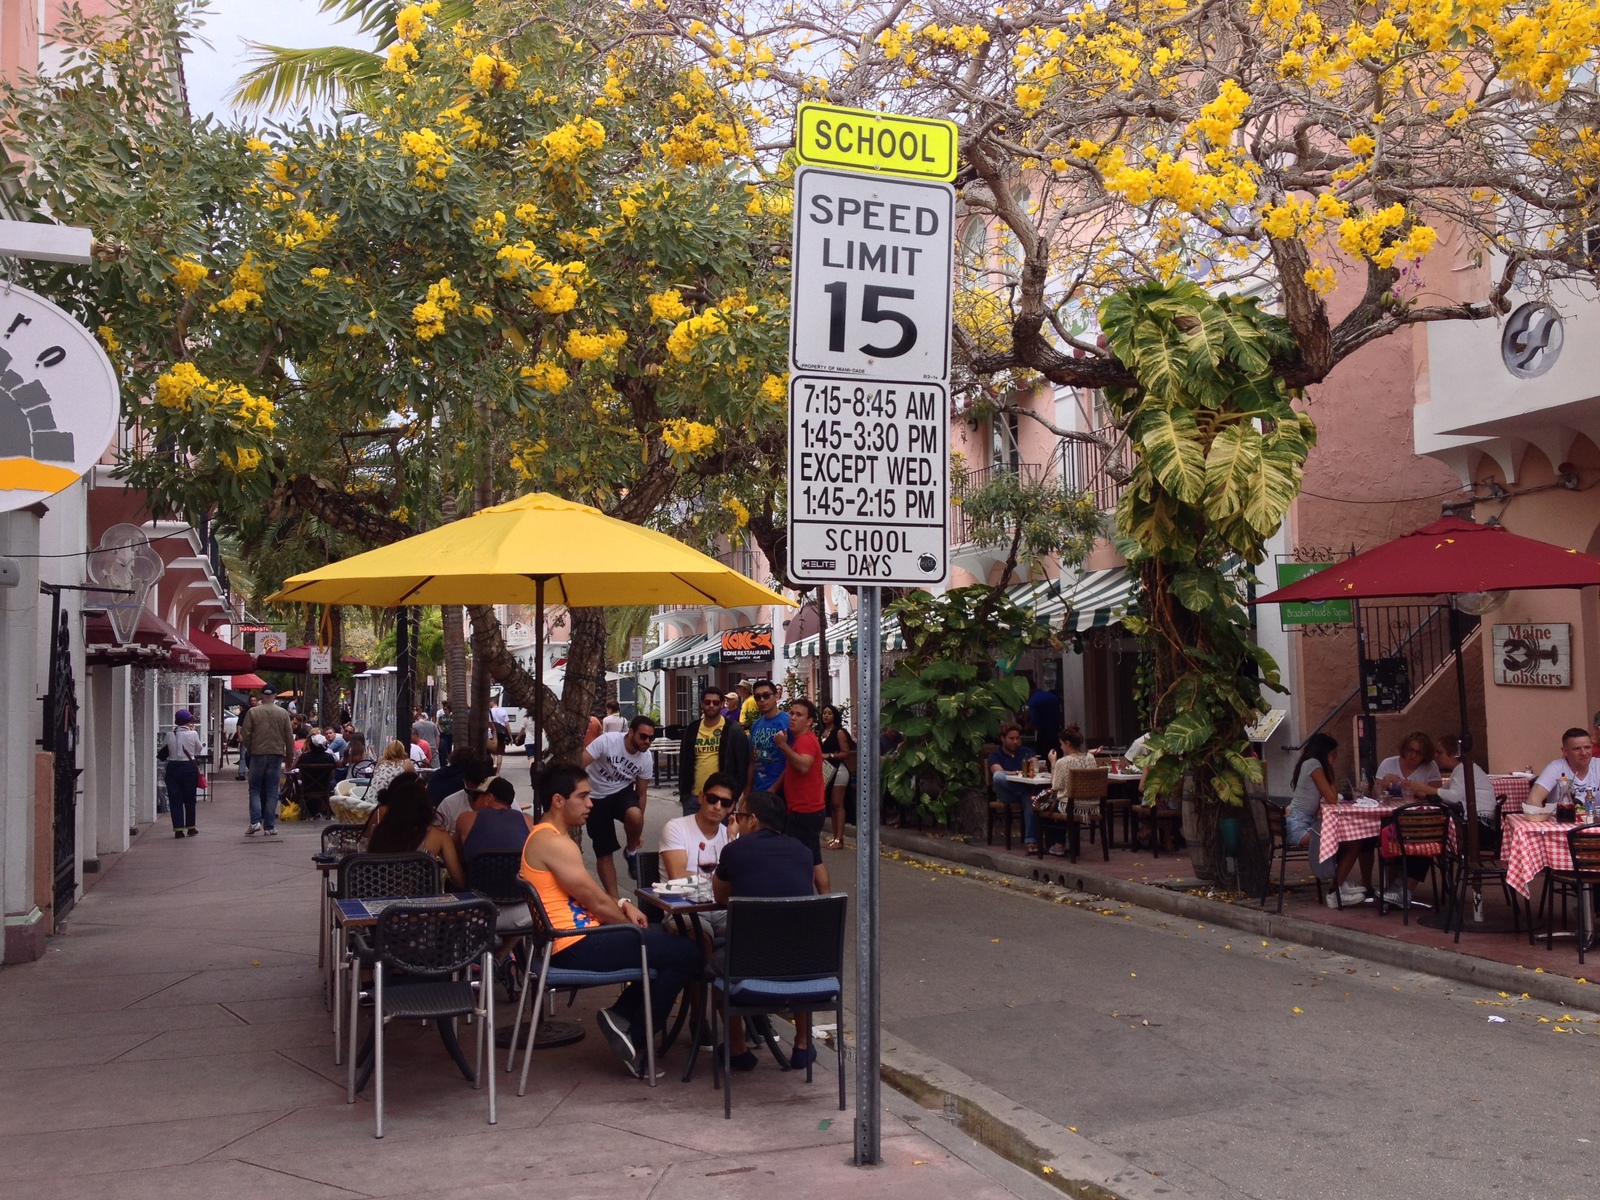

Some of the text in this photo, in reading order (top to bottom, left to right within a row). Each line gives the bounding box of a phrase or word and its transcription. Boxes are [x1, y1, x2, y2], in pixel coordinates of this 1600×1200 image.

[815, 119, 936, 163] SCHOOL
[809, 194, 940, 236] SPEED
[822, 237, 923, 276] LIMIT
[824, 281, 918, 359] 15
[801, 363, 827, 371] PROPERTY
[804, 384, 936, 421] 7:15-8:45 AM
[801, 419, 937, 454] 1:45-3:30 PM
[800, 452, 937, 487] EXCEPT WED.
[803, 486, 935, 519] 1:45-2:15 PM
[826, 528, 913, 553] SCHOOL
[848, 554, 892, 577] DAYS
[1332, 607, 1349, 621] Tapas
[1507, 625, 1552, 640] Maine
[1503, 669, 1562, 685] Lobsters
[694, 745, 720, 753] ILFIGE
[695, 736, 720, 746] RASI
